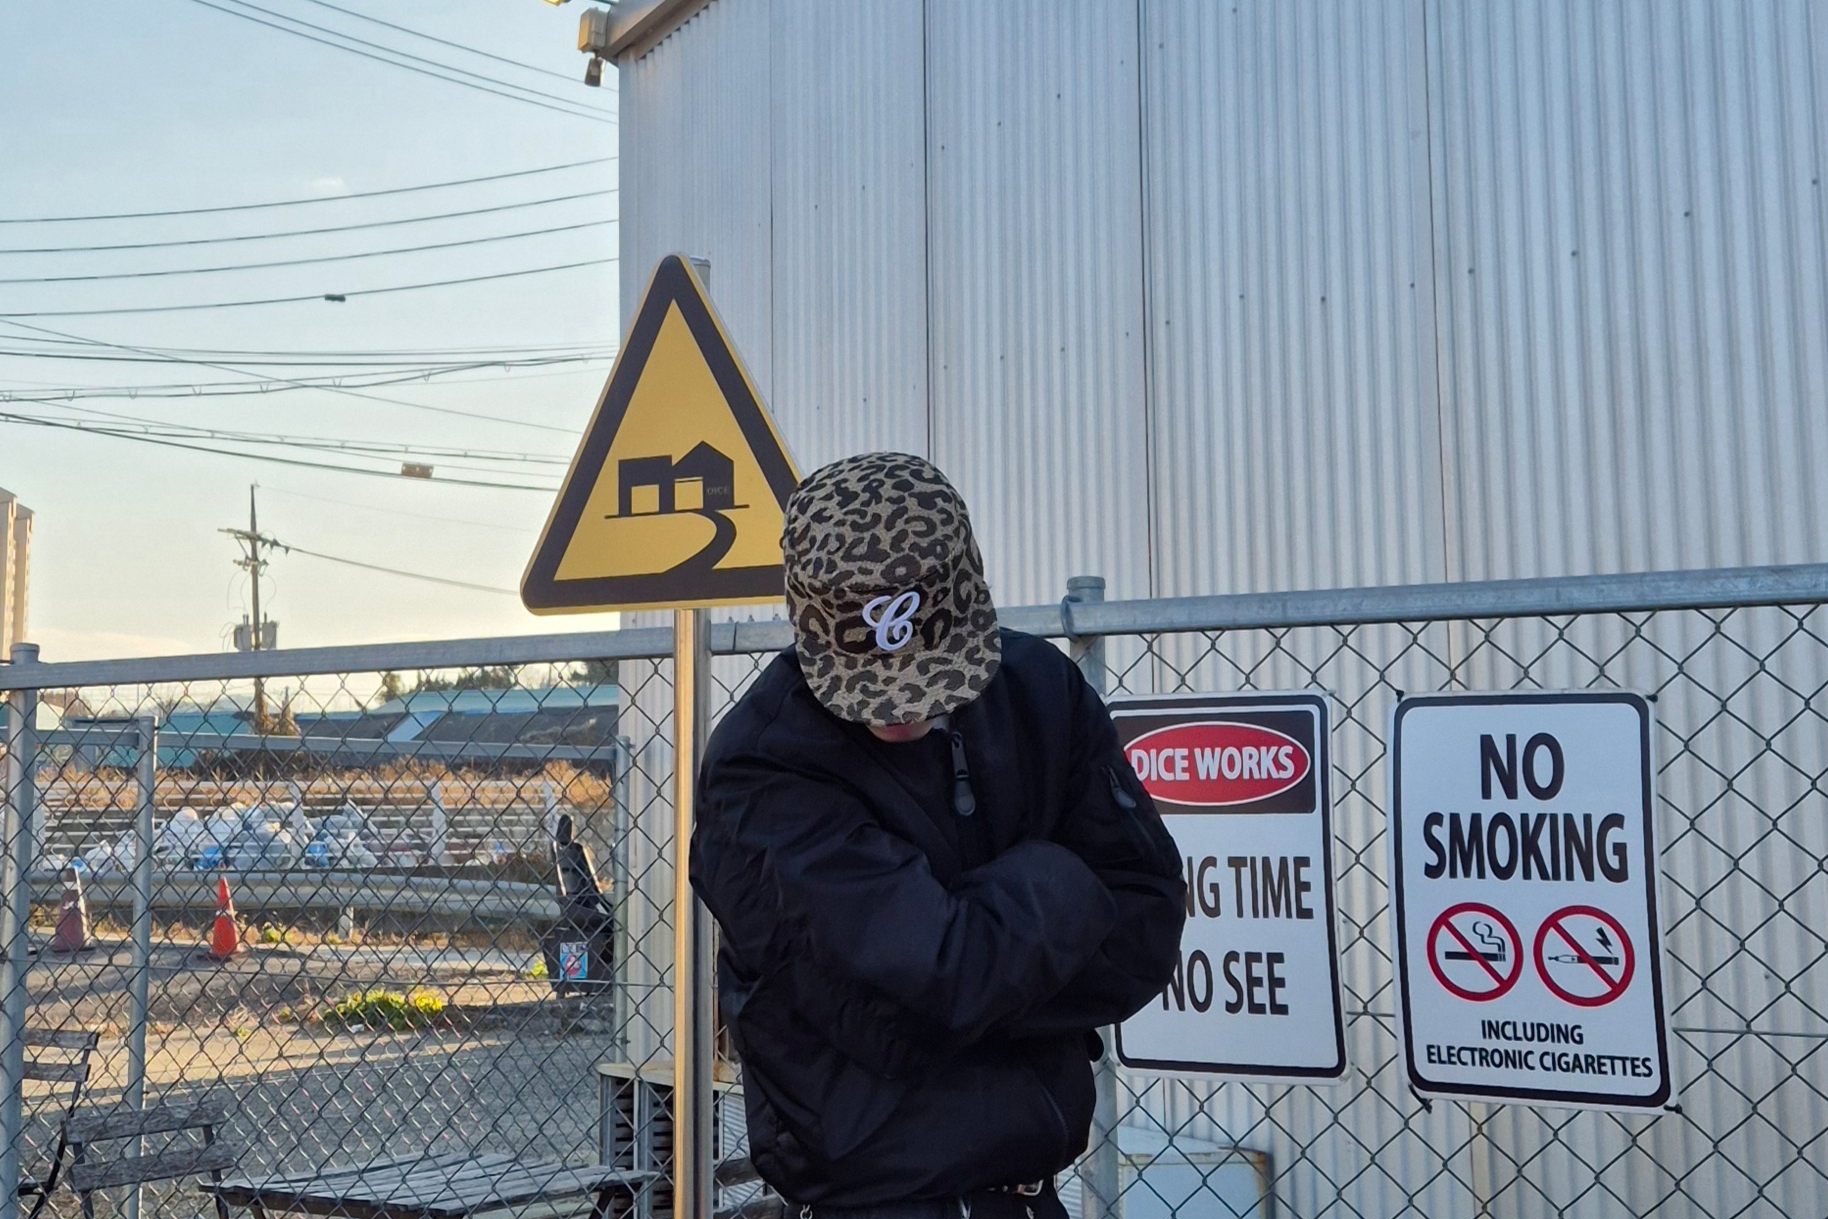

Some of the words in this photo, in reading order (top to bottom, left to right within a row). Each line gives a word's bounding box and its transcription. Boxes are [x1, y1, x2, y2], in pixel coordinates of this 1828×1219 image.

[1131, 748, 1190, 782] DICE
[1194, 745, 1295, 780] WORKS
[1480, 732, 1565, 801] NO
[1423, 811, 1629, 883] SMOKING
[1227, 856, 1314, 919] TIME
[1162, 949, 1213, 1013] NO
[1223, 950, 1289, 1015] SEE
[1426, 1044, 1535, 1071] ELECTRONIC
[1539, 1051, 1653, 1078] CIGARETTES
[1480, 1019, 1584, 1045] INCLUDING
